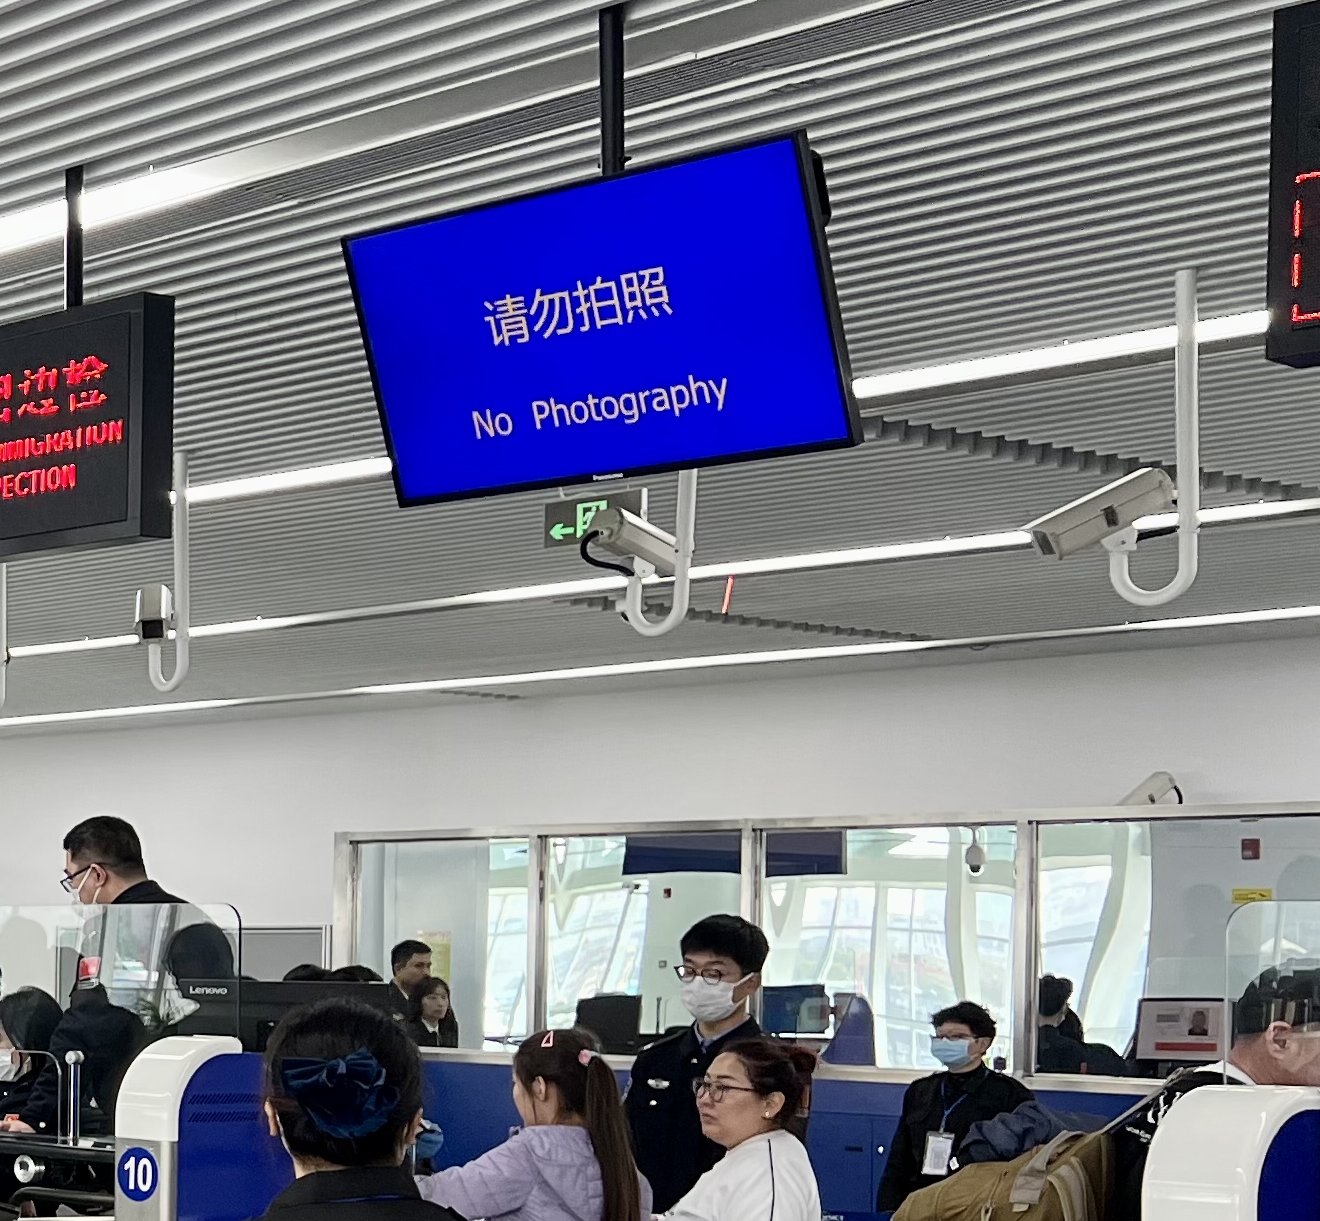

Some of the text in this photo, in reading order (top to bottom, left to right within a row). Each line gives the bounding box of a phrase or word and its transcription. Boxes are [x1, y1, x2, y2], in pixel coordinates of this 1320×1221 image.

[483, 266, 674, 346] 请勿拍照
[471, 374, 728, 439] No Photography
[124, 1156, 152, 1192] 10
